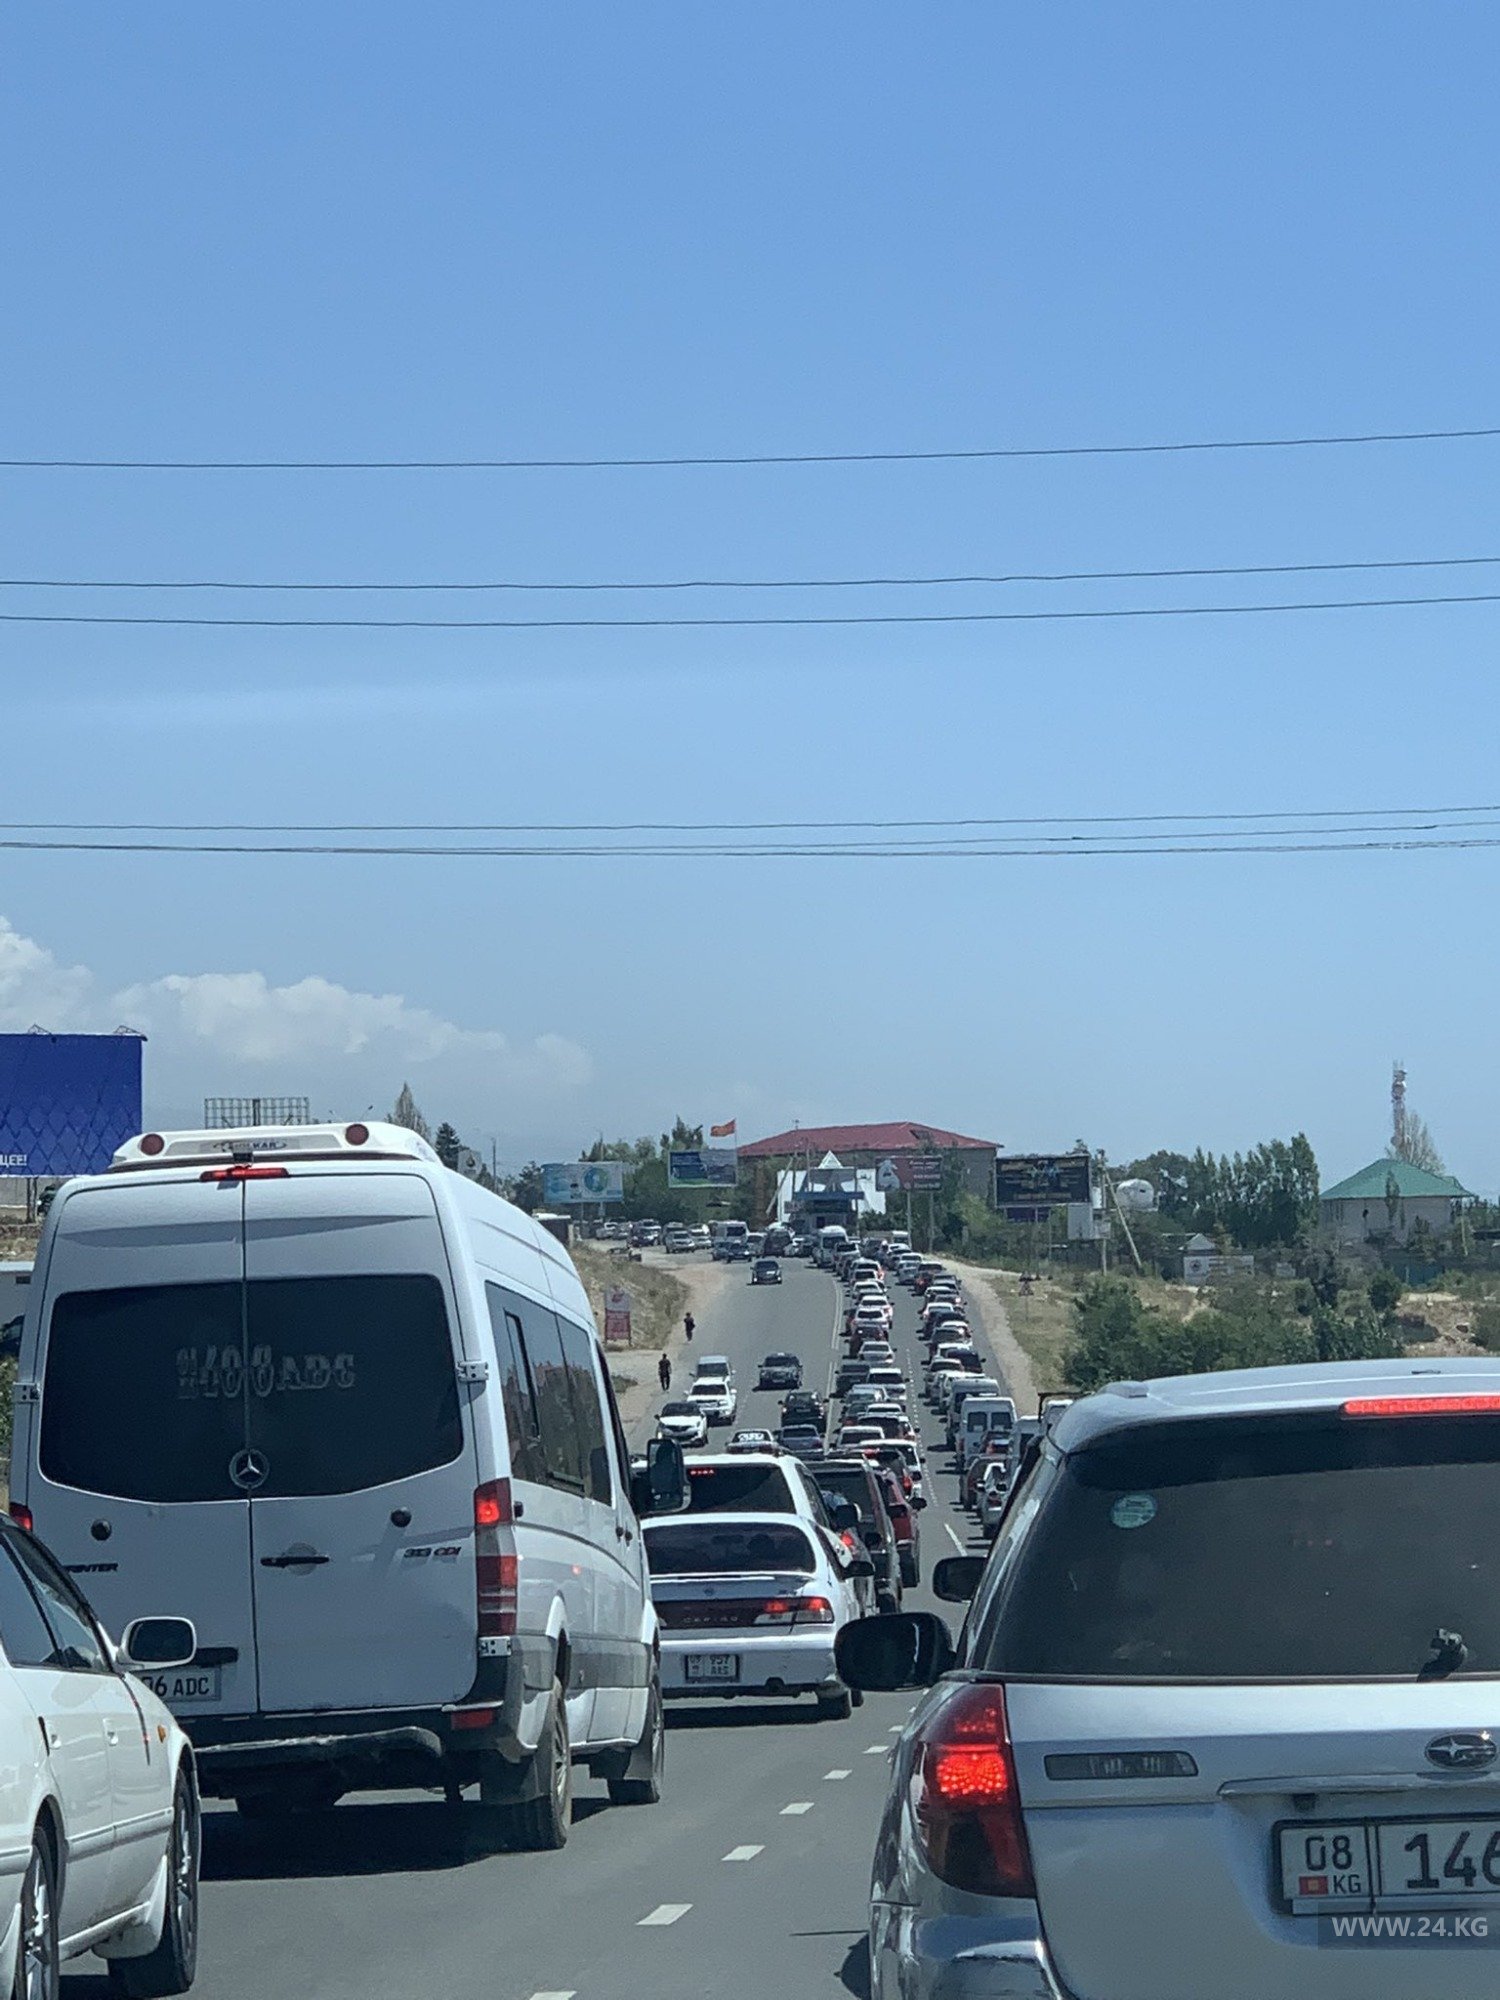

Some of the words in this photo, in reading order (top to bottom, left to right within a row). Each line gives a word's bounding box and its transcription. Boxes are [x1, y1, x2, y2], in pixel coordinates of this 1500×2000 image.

[173, 1677, 209, 1695] ADC
[1305, 1835, 1353, 1871] 08
[1333, 1874, 1361, 1894] KG
